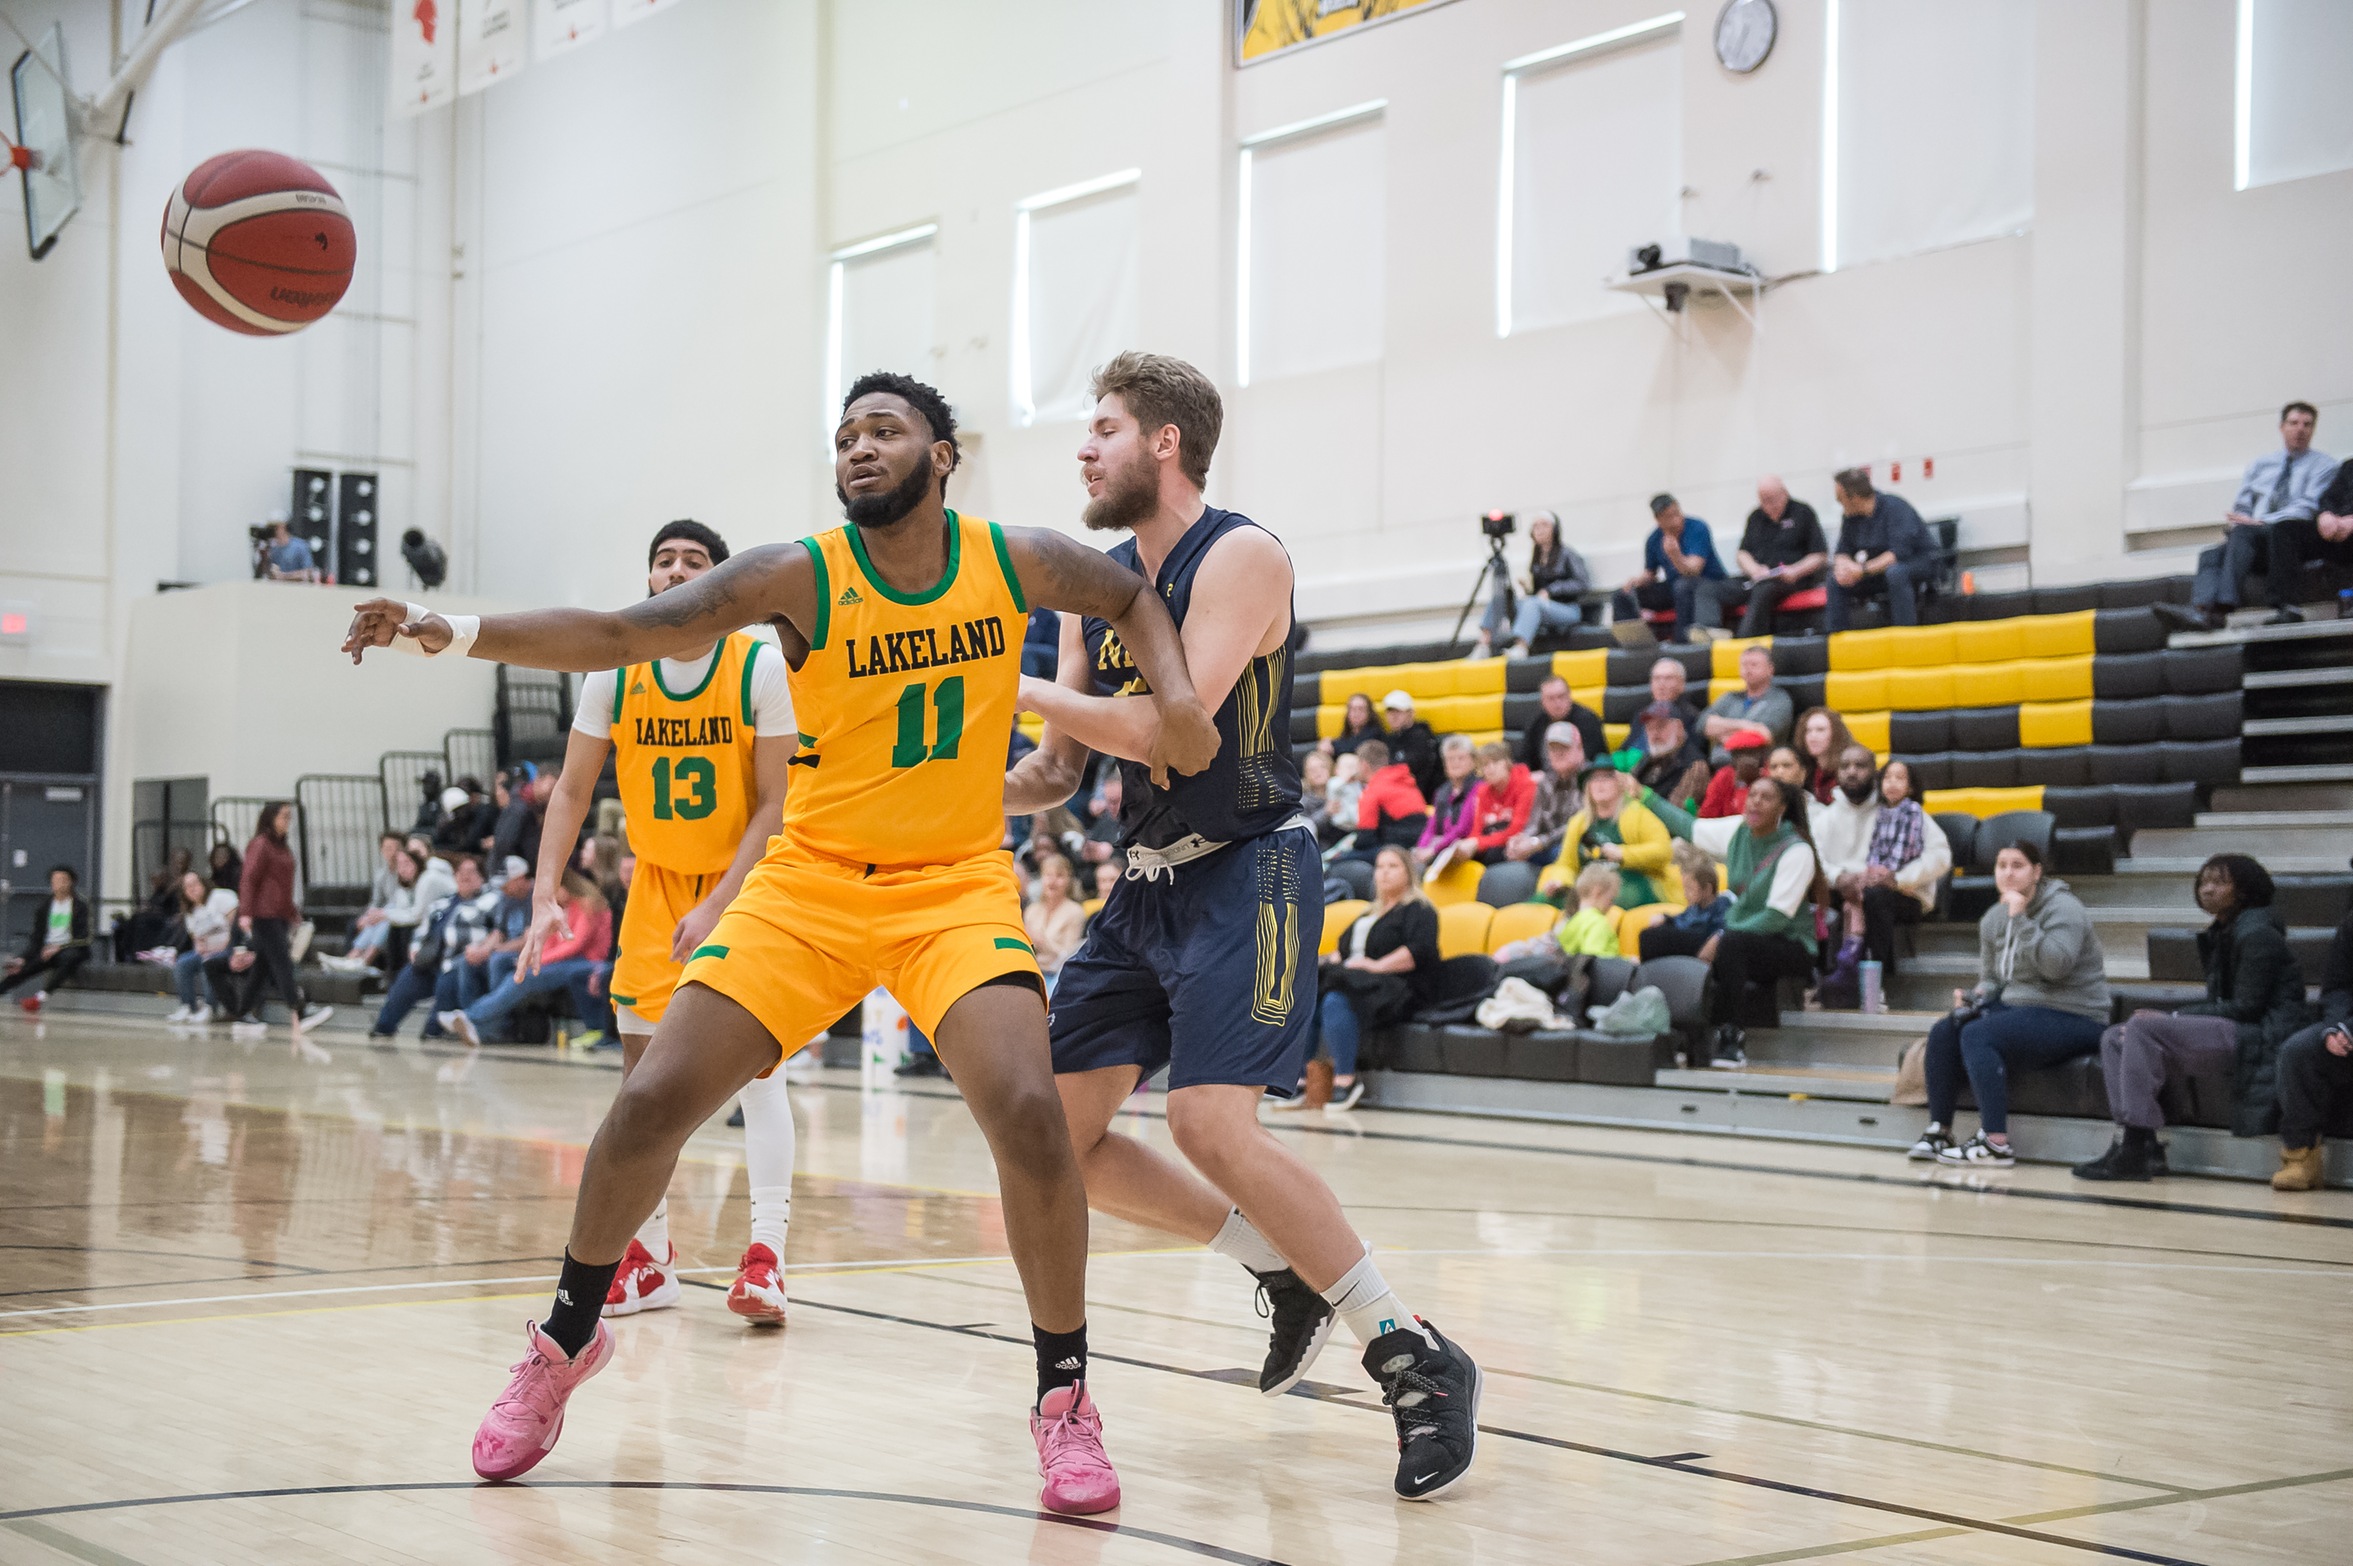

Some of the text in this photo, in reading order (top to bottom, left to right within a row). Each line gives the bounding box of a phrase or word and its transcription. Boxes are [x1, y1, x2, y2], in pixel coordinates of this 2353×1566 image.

[845, 615, 1006, 679] LAKELAND
[891, 675, 965, 768] 11
[651, 756, 718, 820] 13
